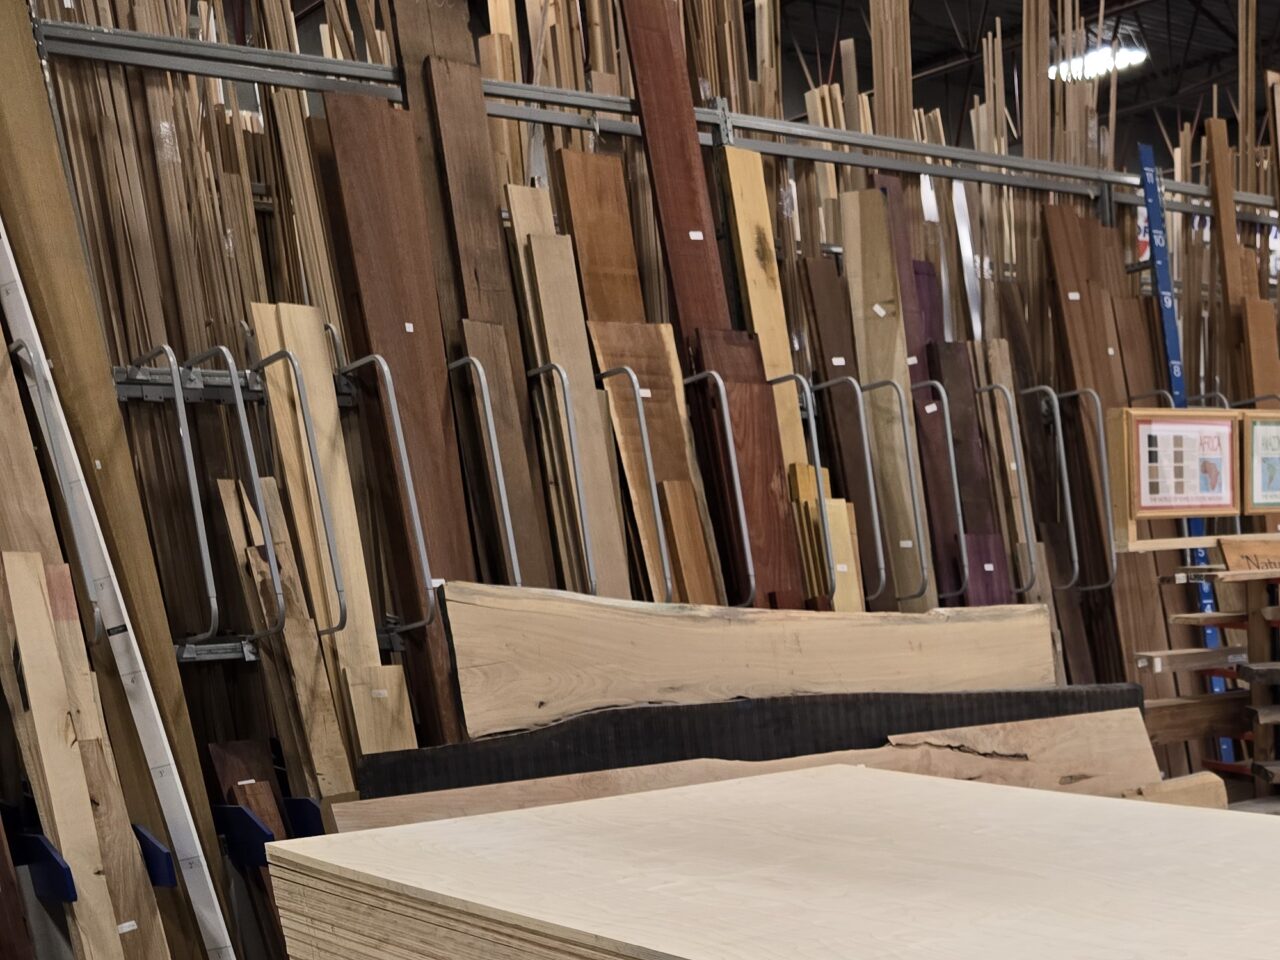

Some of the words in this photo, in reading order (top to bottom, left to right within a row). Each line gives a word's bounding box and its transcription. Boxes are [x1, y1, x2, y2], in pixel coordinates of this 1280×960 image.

[1153, 233, 1165, 247] 10
[1164, 295, 1173, 308] 9
[1172, 363, 1181, 377] 8
